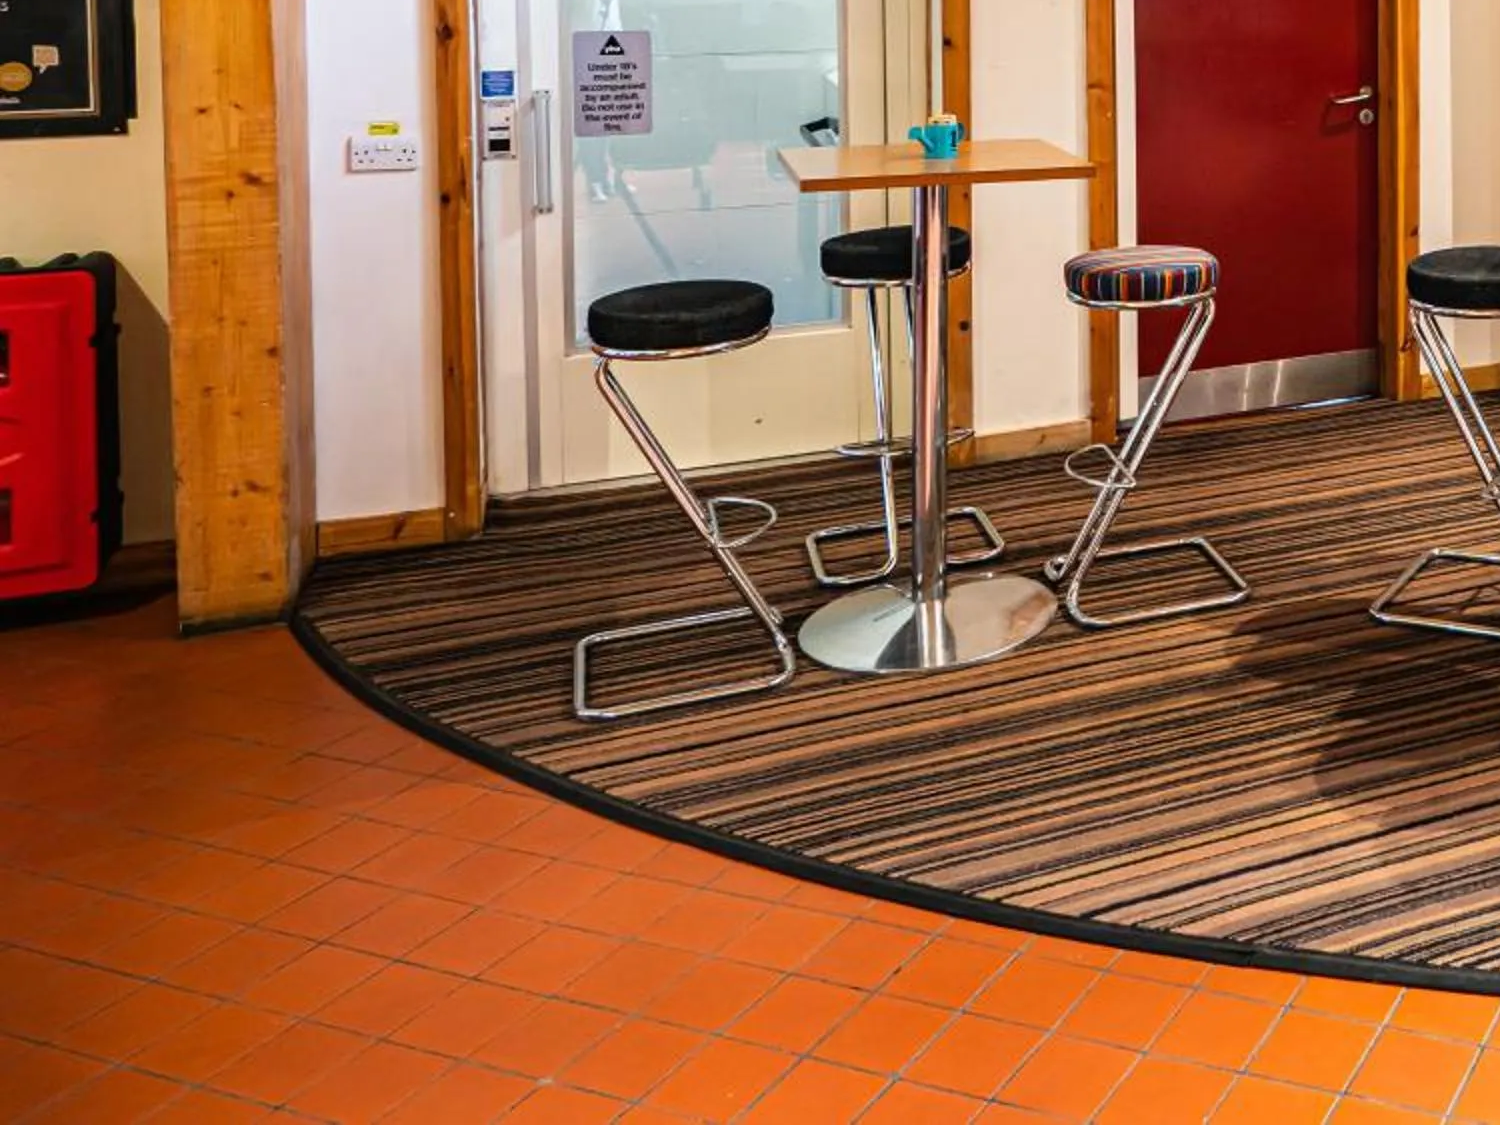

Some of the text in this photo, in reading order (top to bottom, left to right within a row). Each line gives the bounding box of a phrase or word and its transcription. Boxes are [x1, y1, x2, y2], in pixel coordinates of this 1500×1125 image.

[587, 62, 617, 72] Under
[593, 72, 633, 81] must be
[581, 103, 596, 112] Do
[597, 104, 615, 112] not
[585, 112, 643, 122] the event of
